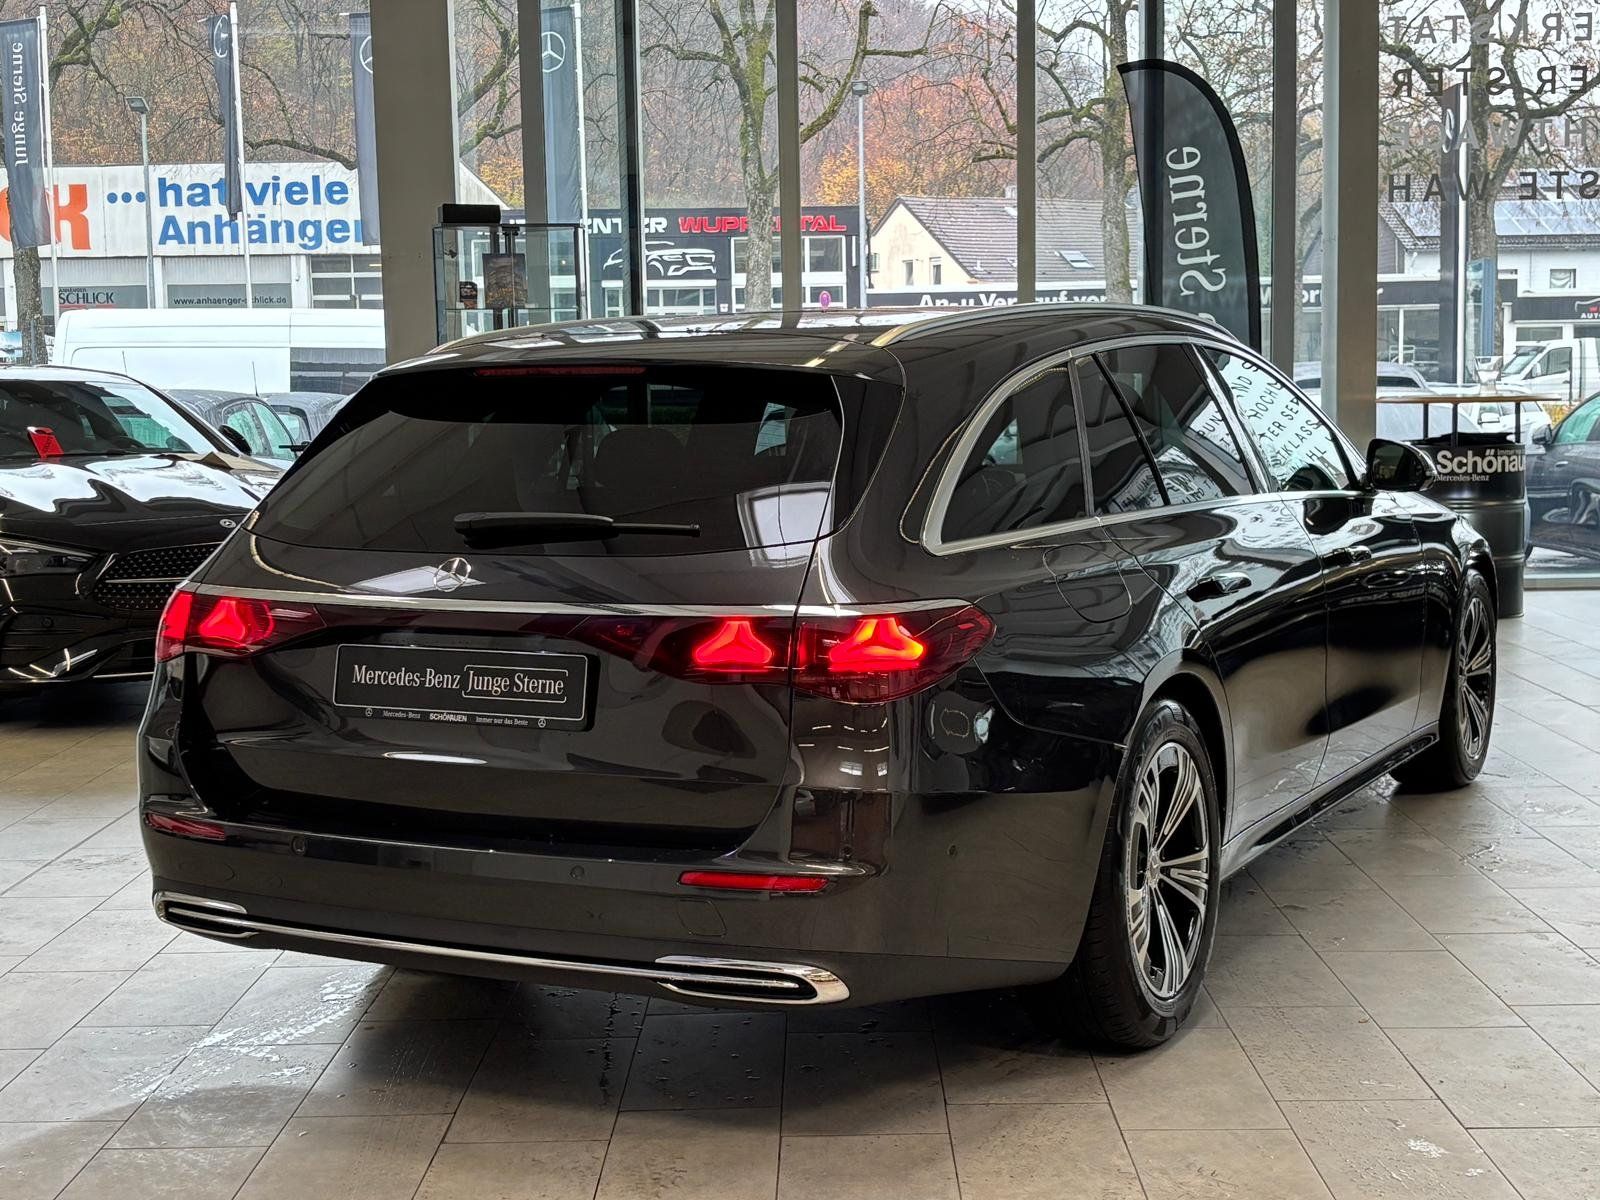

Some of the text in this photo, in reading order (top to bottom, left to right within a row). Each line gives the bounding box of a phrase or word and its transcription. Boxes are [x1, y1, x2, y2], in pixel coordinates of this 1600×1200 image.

[157, 176, 226, 208] hat
[245, 175, 349, 206] viele
[59, 292, 115, 305] SCHLICK
[173, 295, 287, 305] www.anhaenger-hlick.de
[351, 664, 564, 696] Mercedes-Benz Junge Sterne
